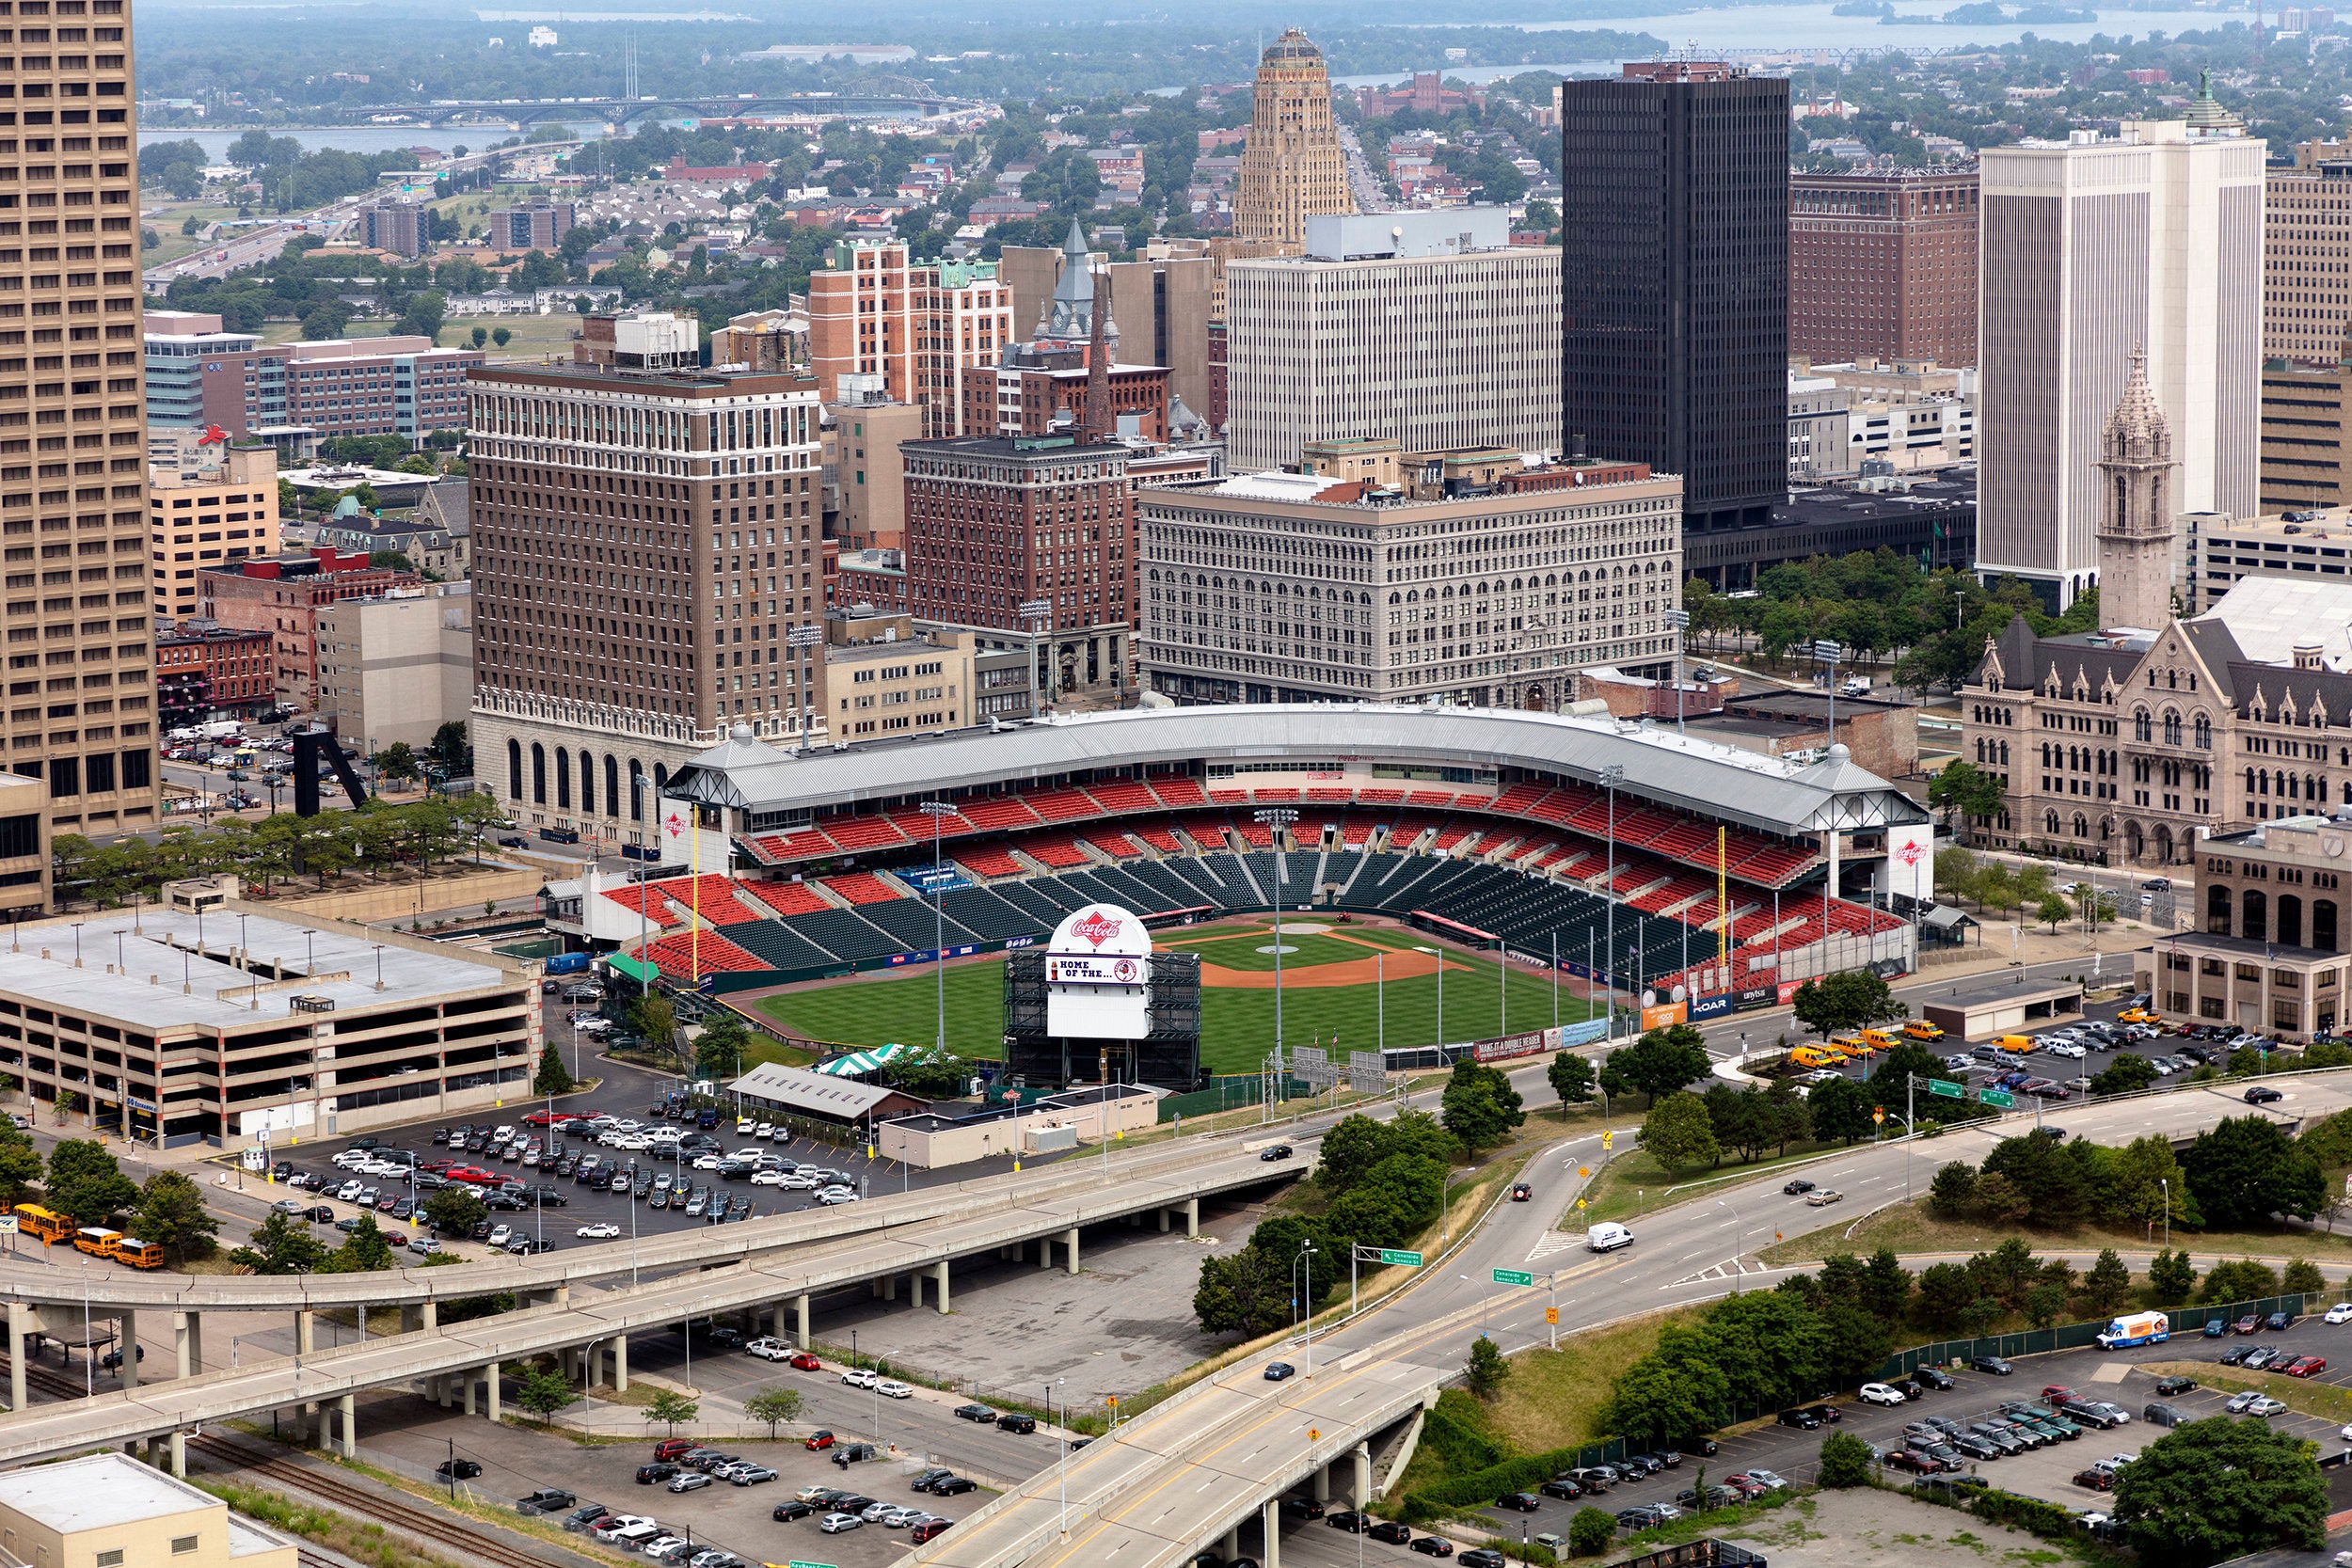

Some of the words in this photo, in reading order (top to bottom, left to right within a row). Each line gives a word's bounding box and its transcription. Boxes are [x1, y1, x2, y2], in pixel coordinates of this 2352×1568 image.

[1893, 845, 1929, 860] Coca-Cola
[1072, 919, 1122, 938] Coca-Cola
[1479, 1043, 1493, 1053] MAKE
[1495, 1041, 1500, 1051] IT
[1523, 1035, 1540, 1046] HEADER
